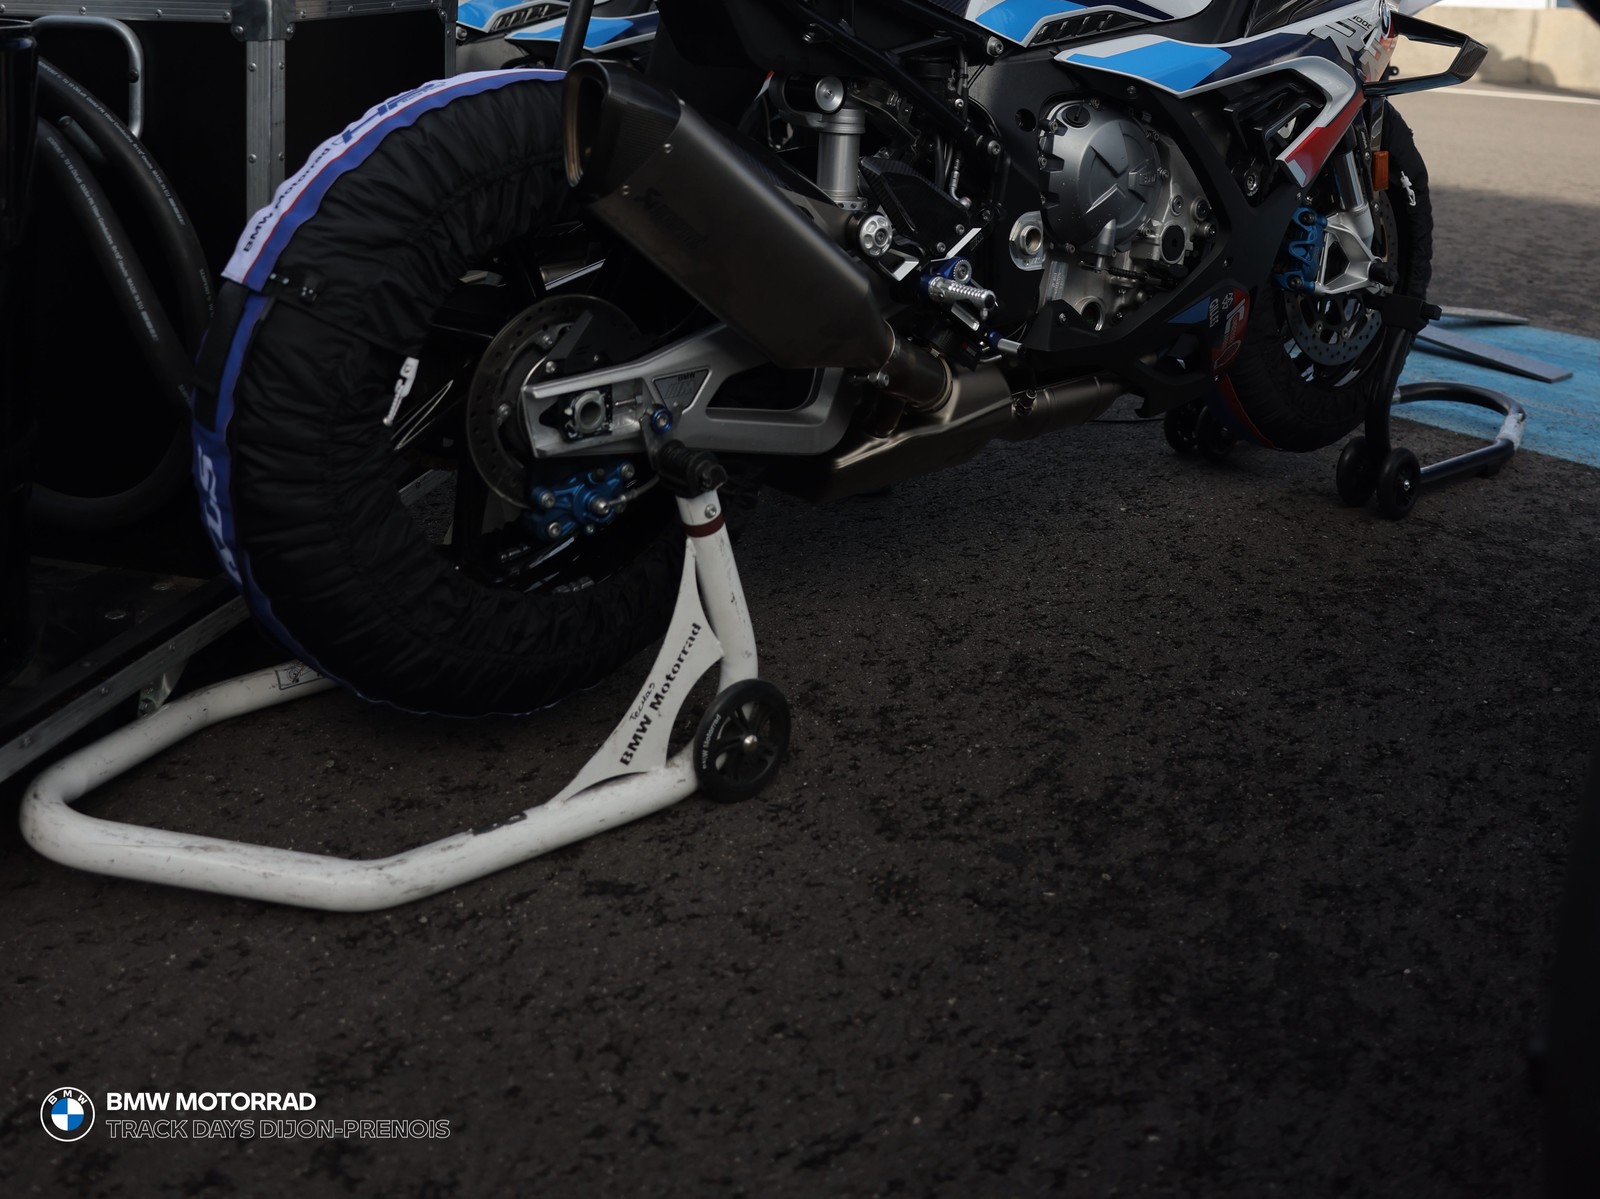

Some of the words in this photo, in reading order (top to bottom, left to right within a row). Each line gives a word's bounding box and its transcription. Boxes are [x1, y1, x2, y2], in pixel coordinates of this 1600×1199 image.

[243, 212, 274, 252] BMW
[274, 147, 331, 210] Motorrad
[620, 715, 652, 766] BMW
[649, 623, 702, 711] Motorrad
